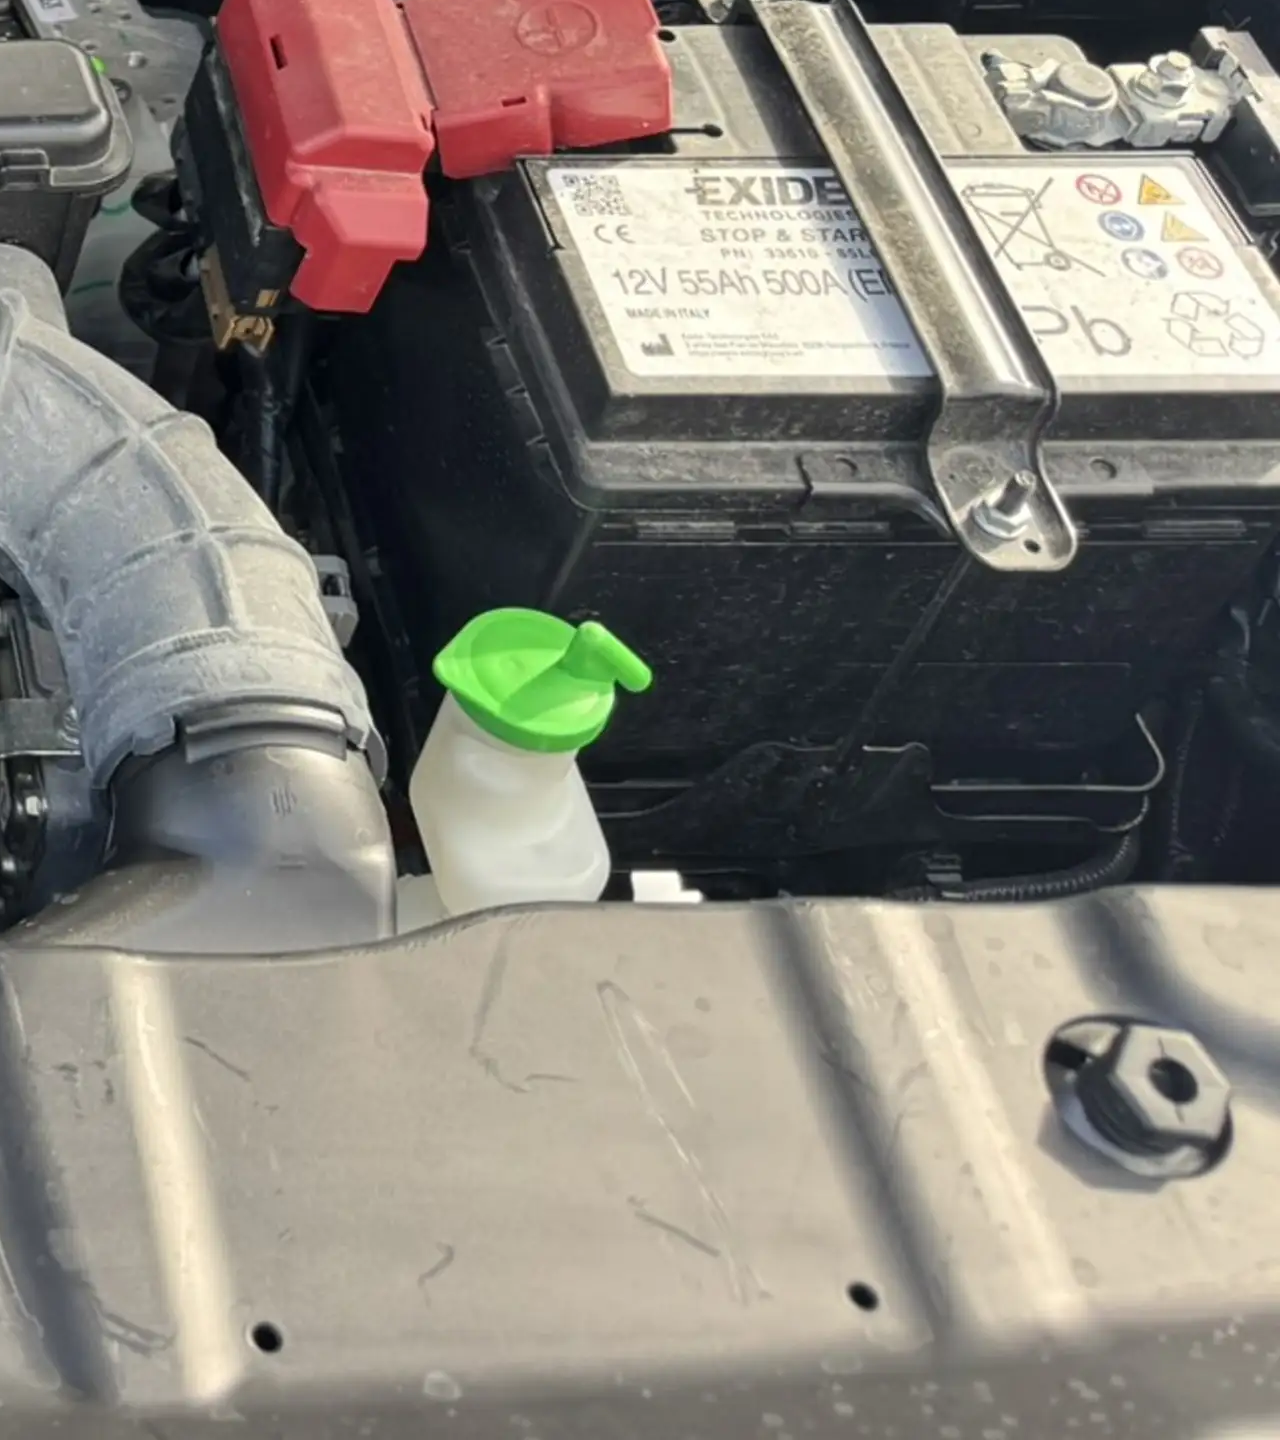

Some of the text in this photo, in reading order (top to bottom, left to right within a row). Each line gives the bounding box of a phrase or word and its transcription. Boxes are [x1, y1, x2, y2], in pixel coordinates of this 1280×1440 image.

[693, 176, 852, 206] EXIDE
[702, 210, 859, 222] TECHNOLOGIES
[700, 228, 870, 244] STOP & STAR
[612, 266, 668, 297] 12V
[677, 268, 761, 297] 55Ah
[762, 268, 848, 297] 500A
[677, 308, 710, 320] ITALY
